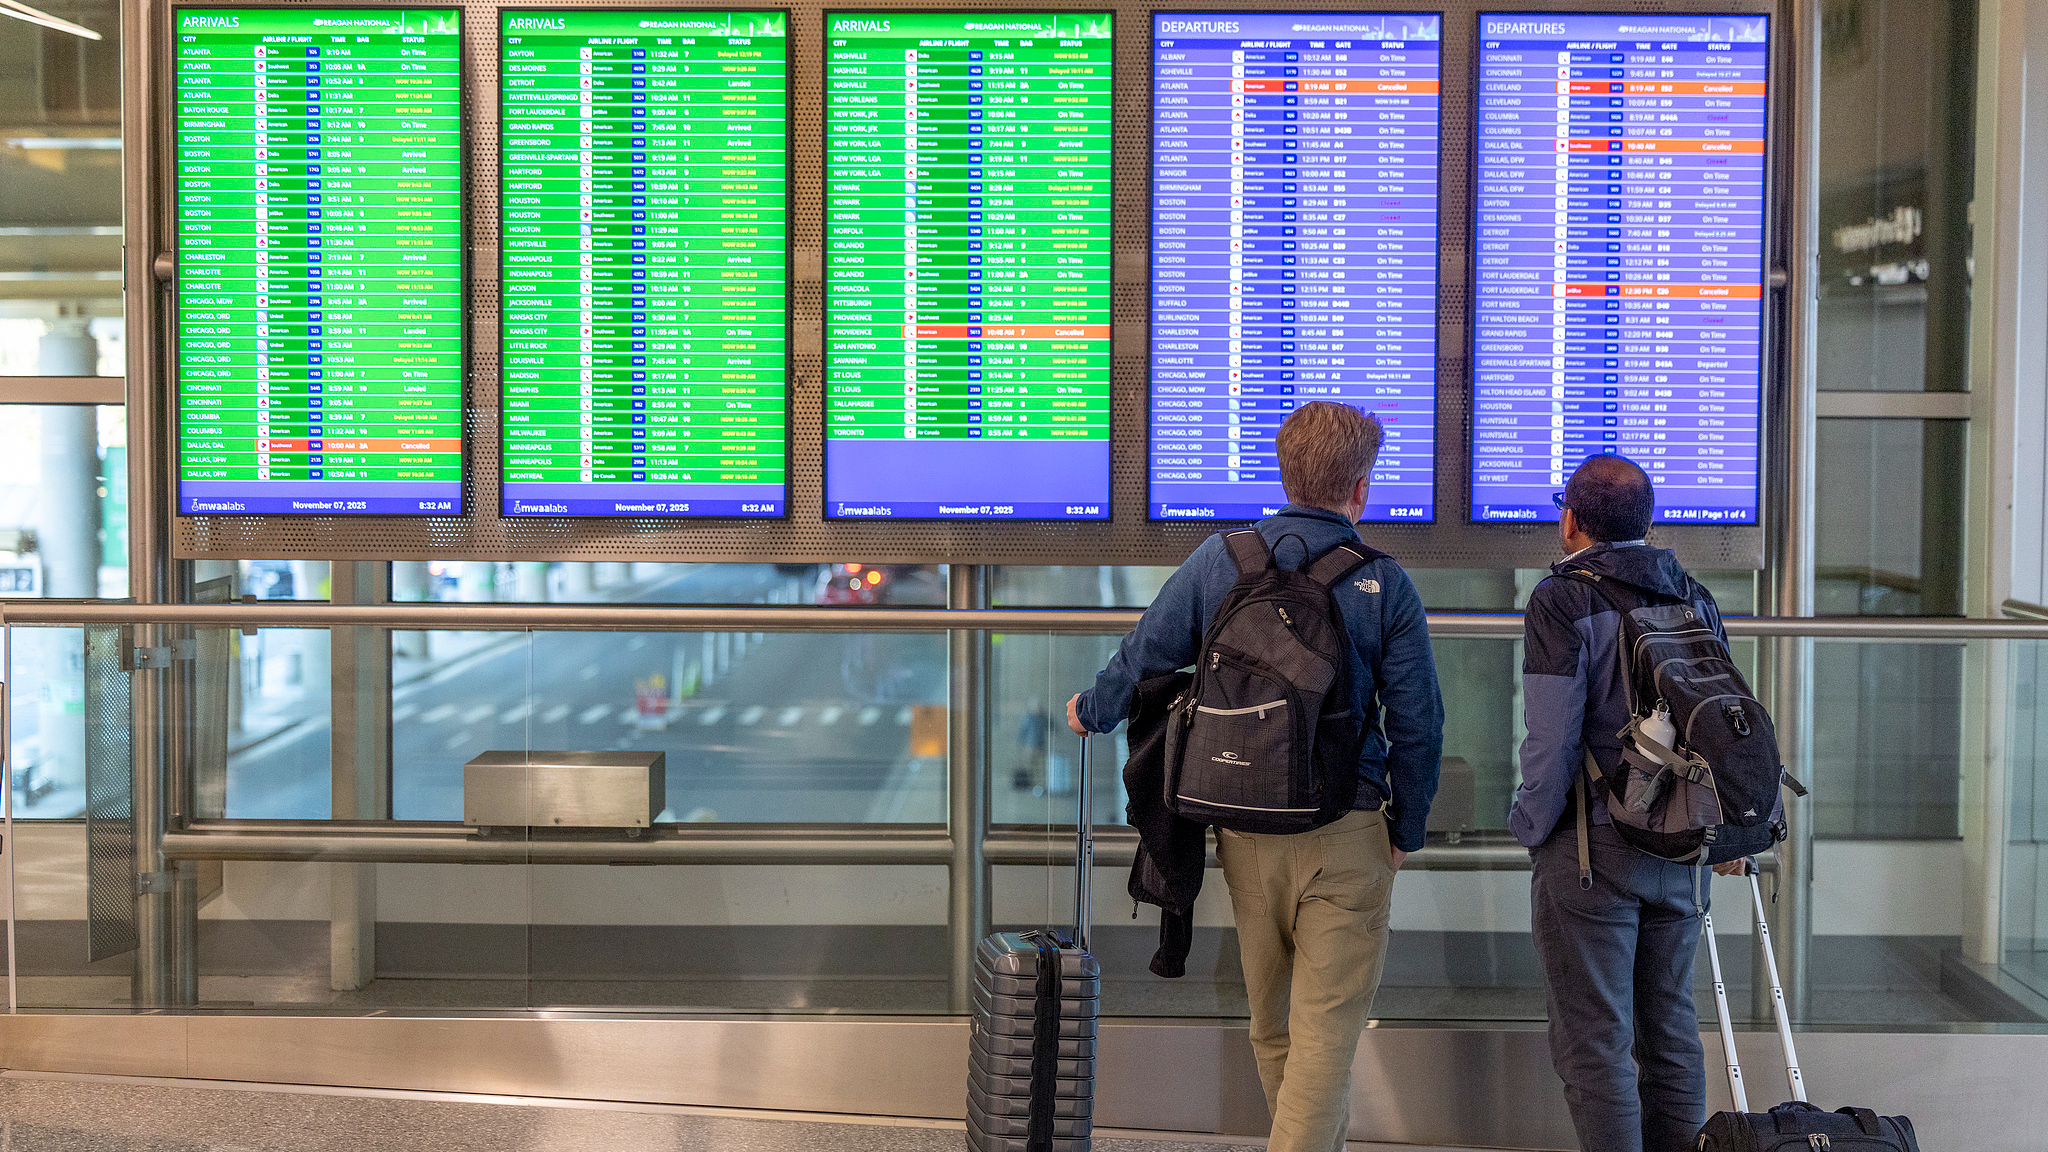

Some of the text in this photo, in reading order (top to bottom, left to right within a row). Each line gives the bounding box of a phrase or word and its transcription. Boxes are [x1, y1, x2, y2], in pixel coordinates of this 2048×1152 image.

[183, 17, 239, 27] ARRIVALS
[509, 18, 565, 29] ARRIVALS
[834, 21, 890, 32] ARRIVALS
[1162, 22, 1239, 33] DEPARTURES
[1488, 23, 1565, 34] DEPARTURES
[199, 502, 245, 510] mwaalabs
[334, 502, 345, 510] 07,
[521, 504, 567, 512] mwaalabs
[656, 504, 668, 512] 07,
[845, 506, 891, 515] mwaalabs
[980, 506, 992, 514] 07,
[1168, 508, 1214, 516] mwaalabs
[1490, 509, 1537, 518] mwaalabs
[1702, 510, 1722, 520] Page
[1730, 510, 1739, 518] of
